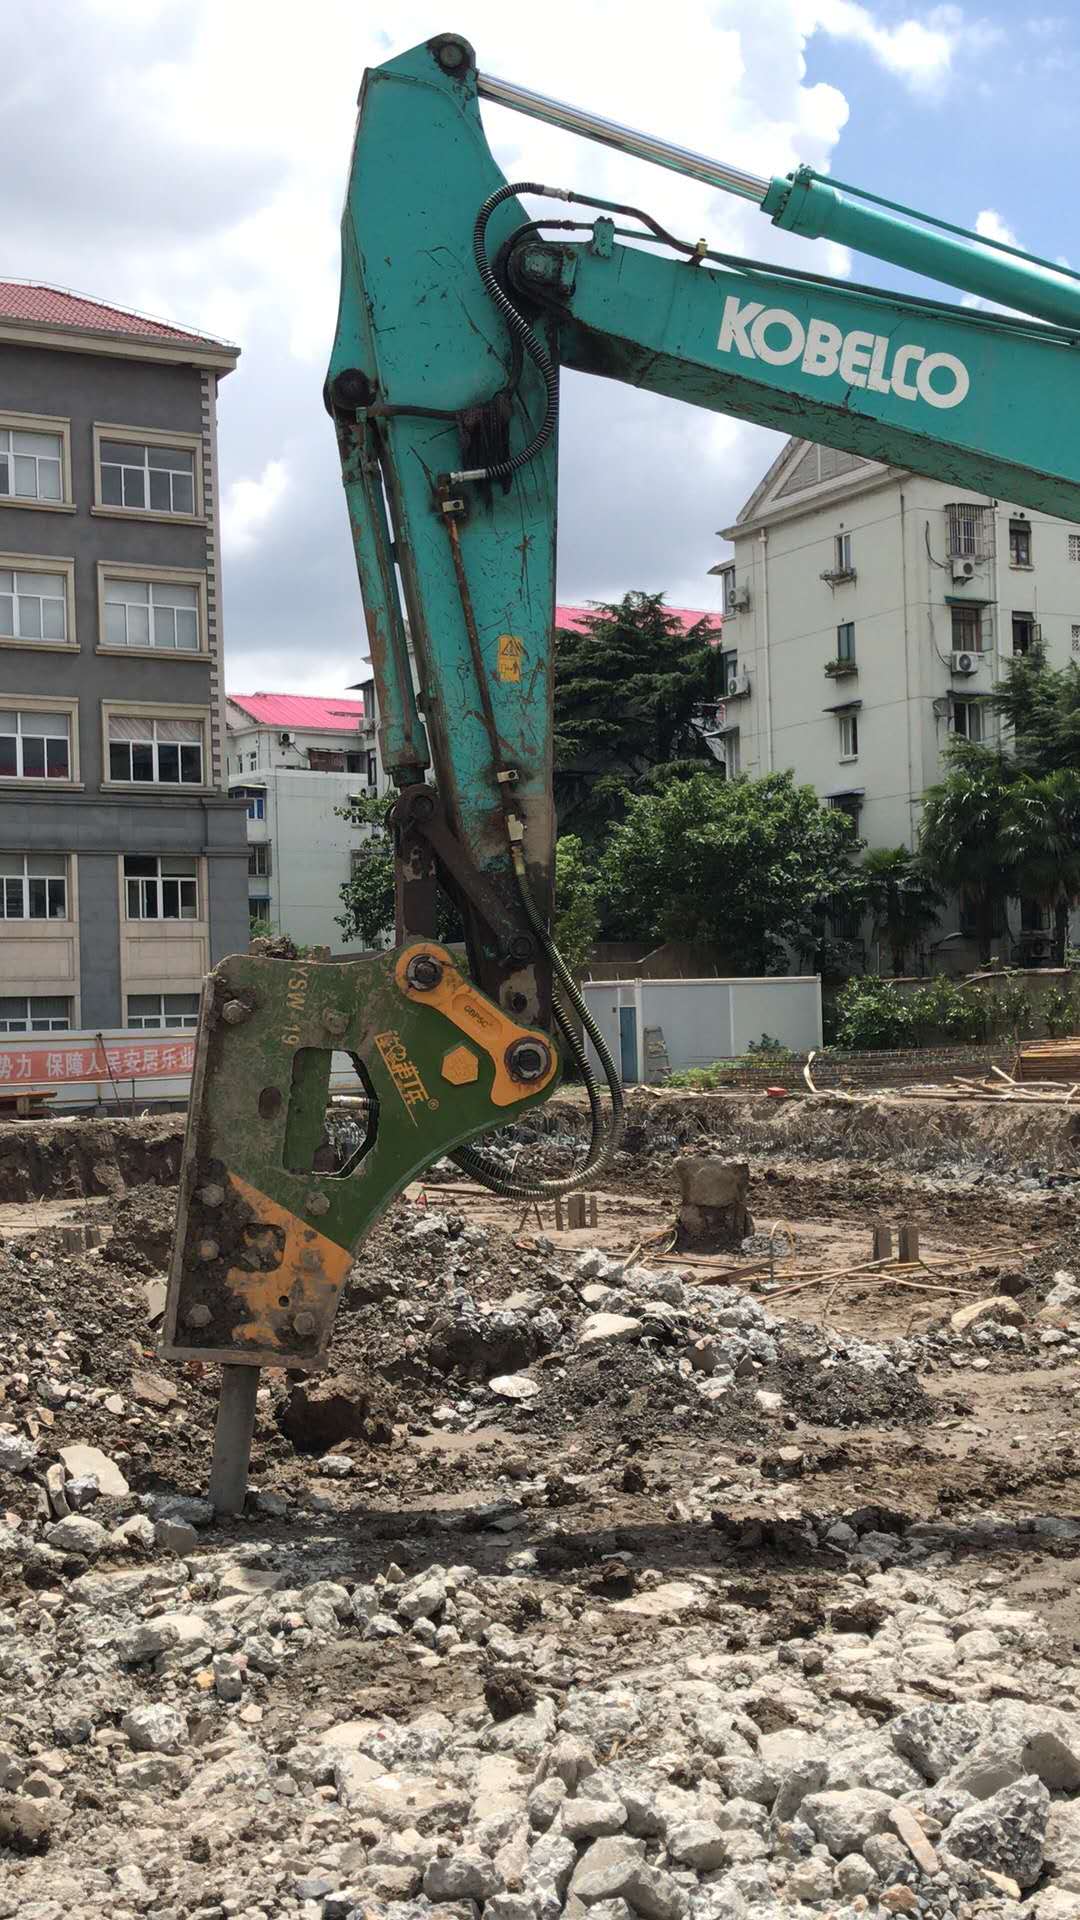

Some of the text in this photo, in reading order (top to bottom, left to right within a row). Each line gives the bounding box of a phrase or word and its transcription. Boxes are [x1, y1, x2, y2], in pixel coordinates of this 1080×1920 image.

[717, 296, 970, 409] KOBELCO
[46, 1045, 195, 1077] 保障人民安居乐业
